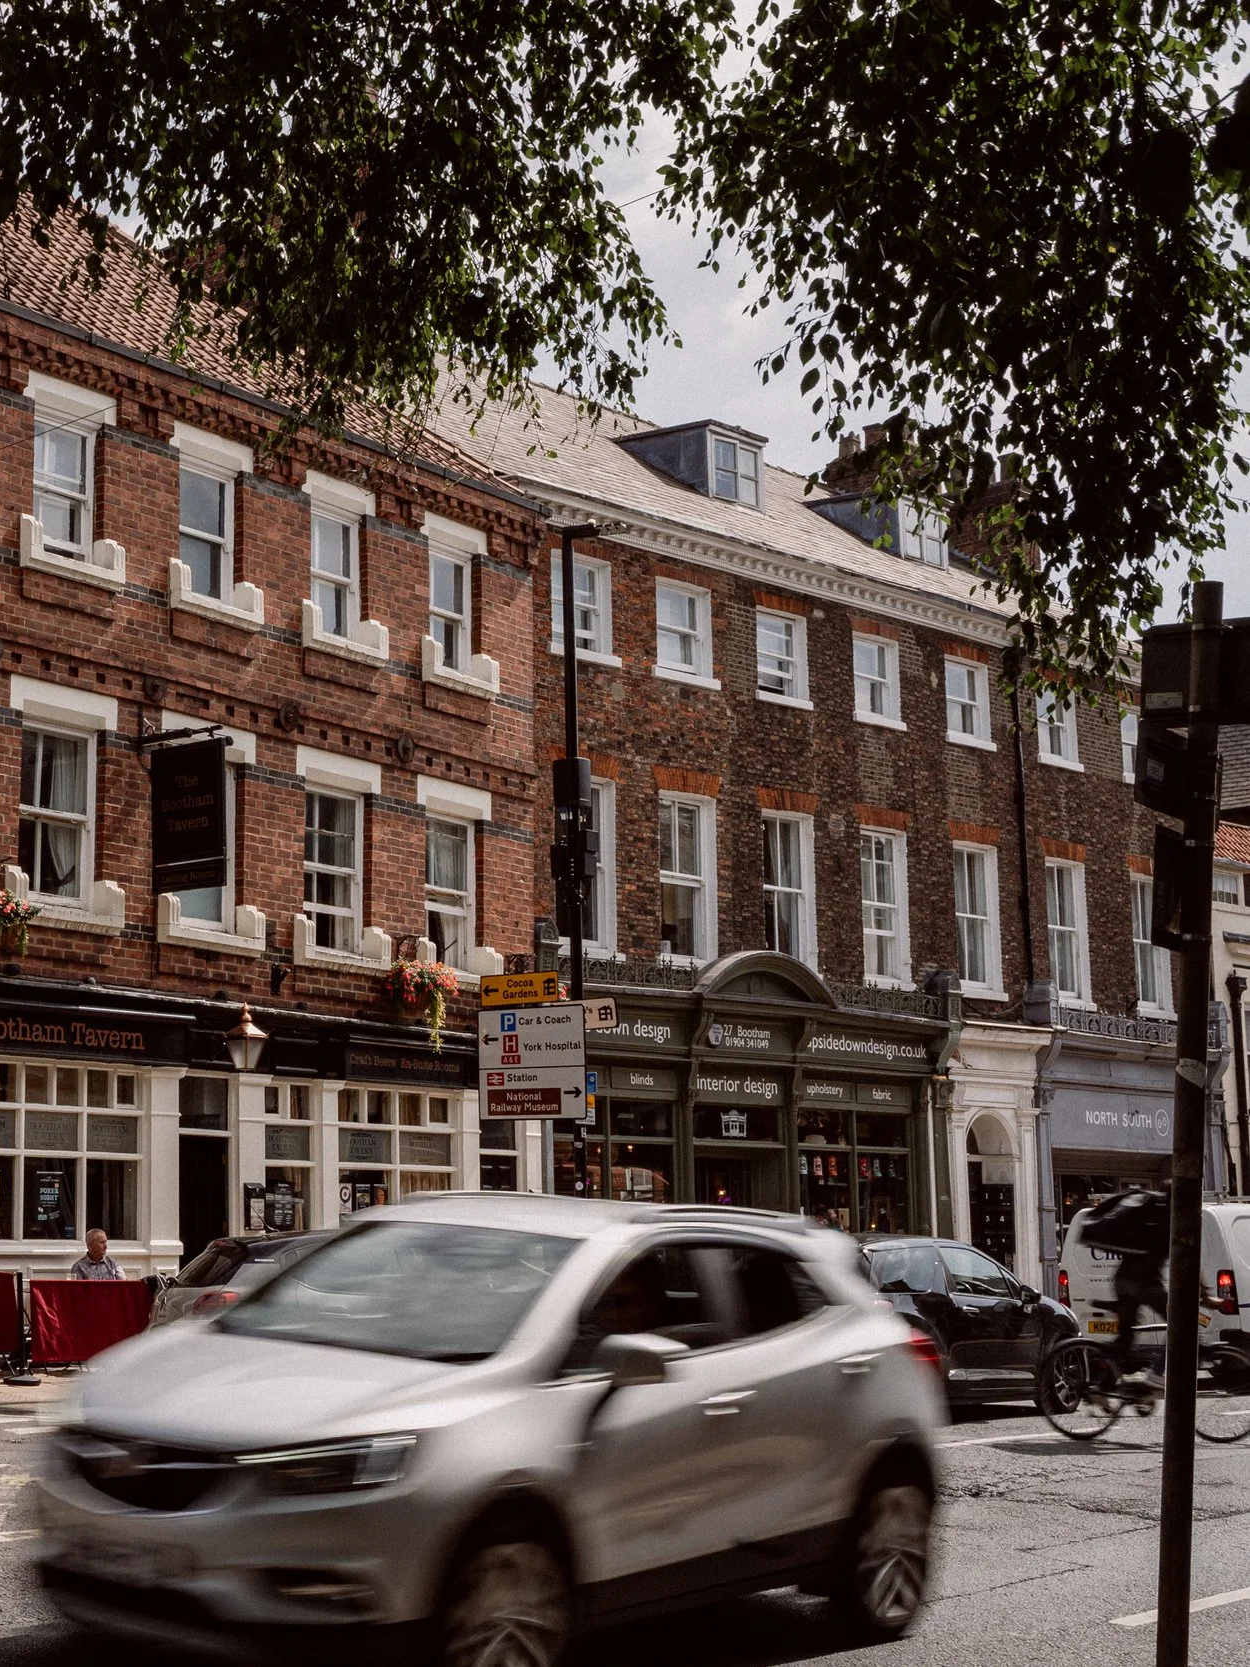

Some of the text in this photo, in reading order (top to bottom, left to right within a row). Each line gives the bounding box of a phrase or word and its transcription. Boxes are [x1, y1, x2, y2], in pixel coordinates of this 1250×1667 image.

[175, 775, 198, 788] The
[161, 793, 215, 812] Bootham
[166, 815, 209, 832] Tavern
[506, 979, 533, 988] Cocoa
[502, 989, 538, 999] Gardens
[504, 1014, 571, 1031] P Car & Coach
[71, 1022, 146, 1050] Tavern
[723, 1024, 734, 1036] 27
[737, 1025, 770, 1039] Bootham
[504, 1036, 581, 1052] H York Hospital
[725, 1036, 769, 1049] 01904 341049
[350, 1053, 372, 1065] Craft
[374, 1055, 396, 1067] Beers
[435, 1060, 460, 1072] Rooms
[503, 1056, 519, 1064] A&E
[507, 1073, 537, 1082] Station
[630, 1072, 654, 1086] blinds
[696, 1073, 778, 1099] interior design
[806, 1083, 843, 1098] upholstery
[506, 1092, 542, 1101] National
[872, 1088, 892, 1101] fabric
[490, 1102, 558, 1113] Railway Museum
[1085, 1110, 1152, 1129] NORTH SOUTH
